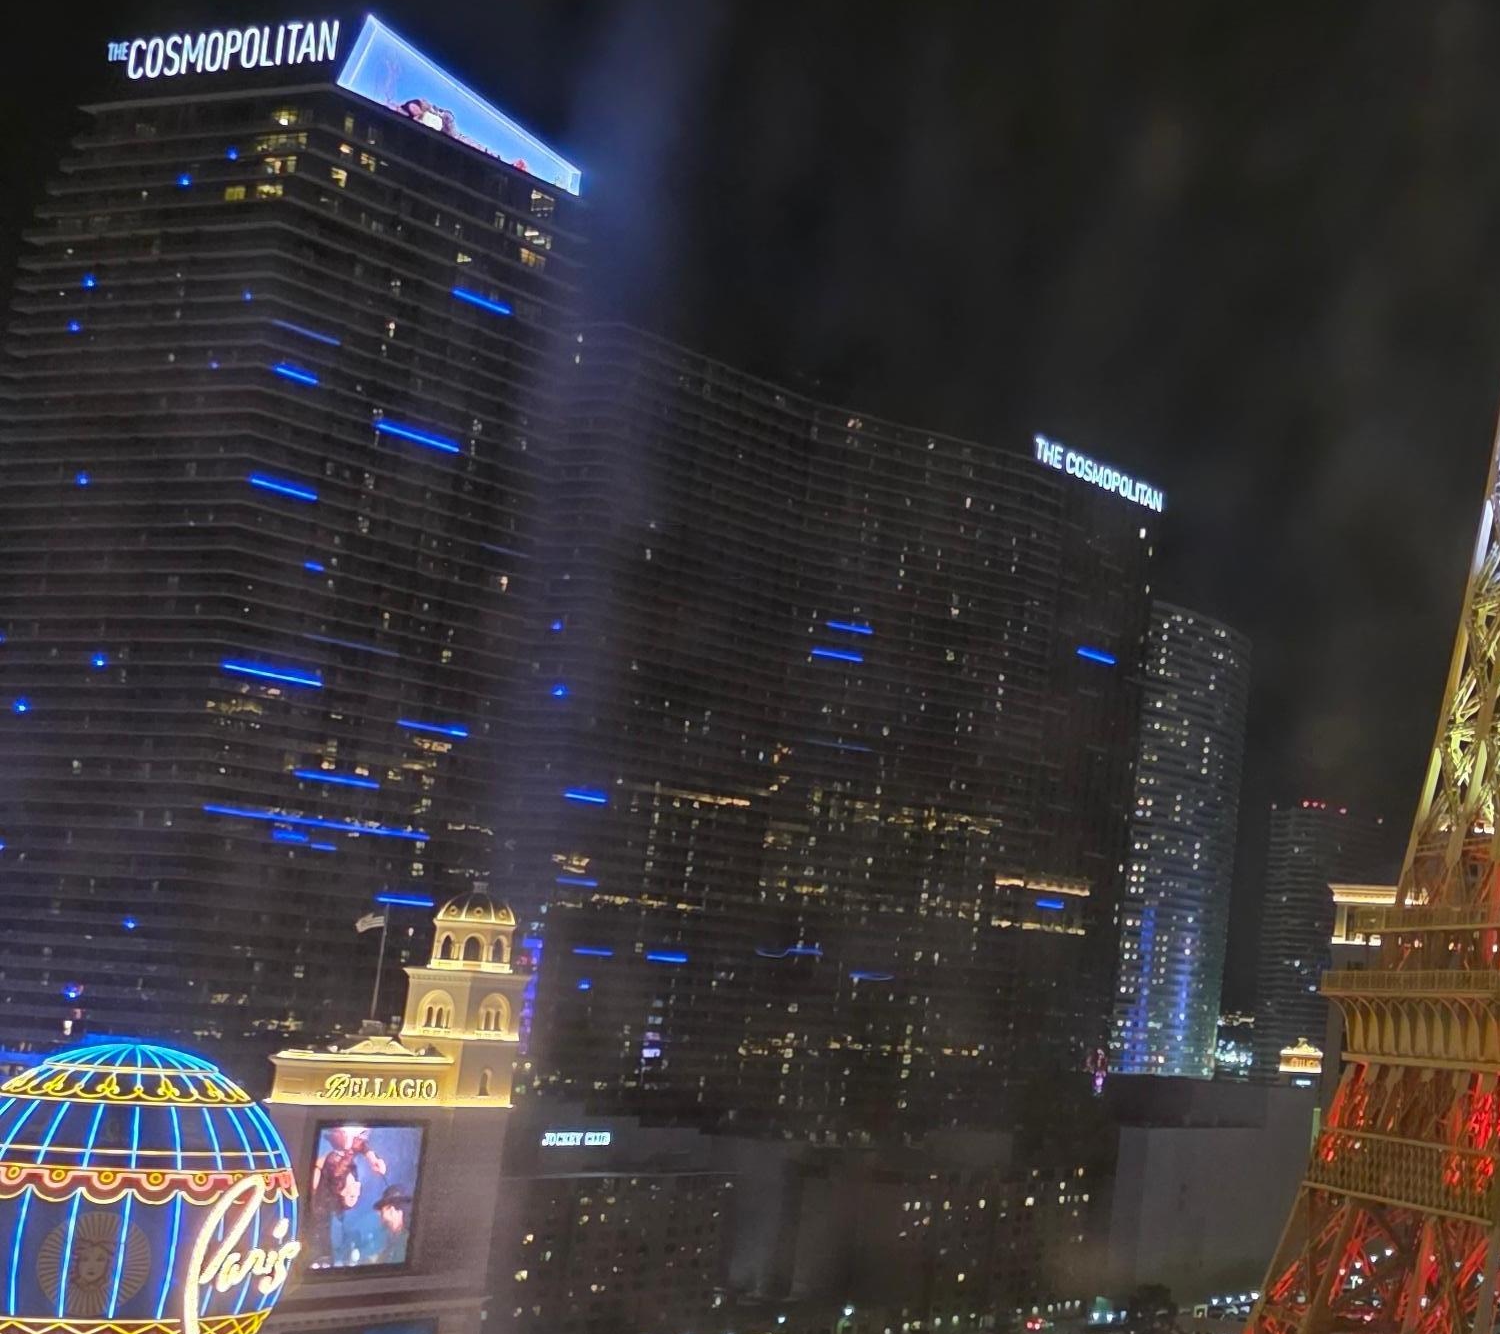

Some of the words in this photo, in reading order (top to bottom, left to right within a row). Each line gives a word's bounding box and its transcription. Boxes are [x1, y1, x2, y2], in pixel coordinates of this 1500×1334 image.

[107, 41, 130, 62] THE
[127, 20, 340, 80] COSMOPOLITAN
[1035, 437, 1064, 470] THE
[1065, 451, 1163, 513] COSMOPOLITAN
[315, 1073, 438, 1100] BELLAGIO
